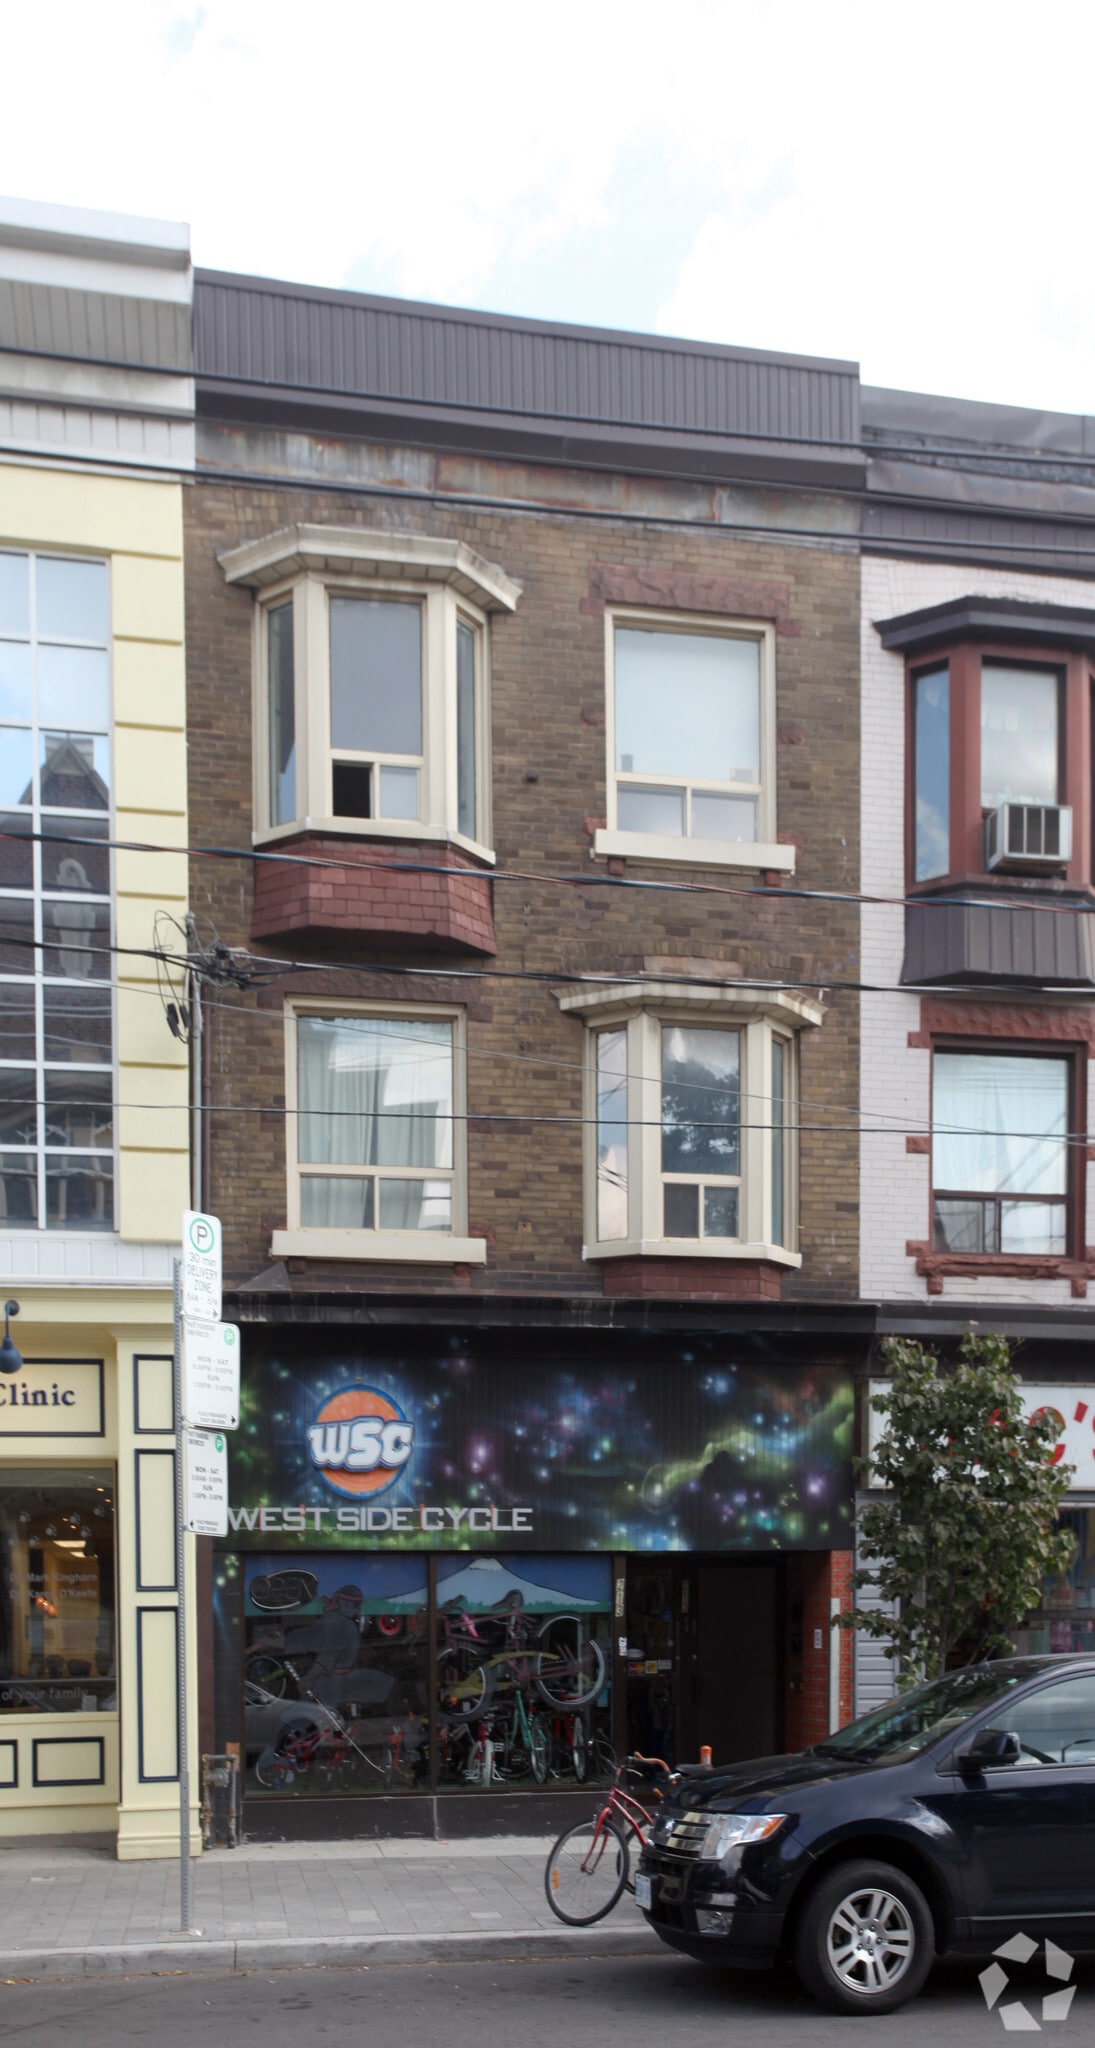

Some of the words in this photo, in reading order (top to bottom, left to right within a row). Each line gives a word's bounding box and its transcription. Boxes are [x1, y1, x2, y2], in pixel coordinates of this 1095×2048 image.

[196, 1224, 208, 1244] P
[187, 1263, 218, 1281] DELIVERY
[194, 1279, 213, 1294] ZONE
[308, 1417, 414, 1471] WSC
[228, 1507, 330, 1532] WEST
[337, 1507, 414, 1532] SIDE
[421, 1507, 534, 1532] CYCLE
[250, 1577, 313, 1600] OPEN
[1, 1688, 14, 1701] of
[15, 1689, 45, 1703] your
[49, 1687, 89, 1701] family
